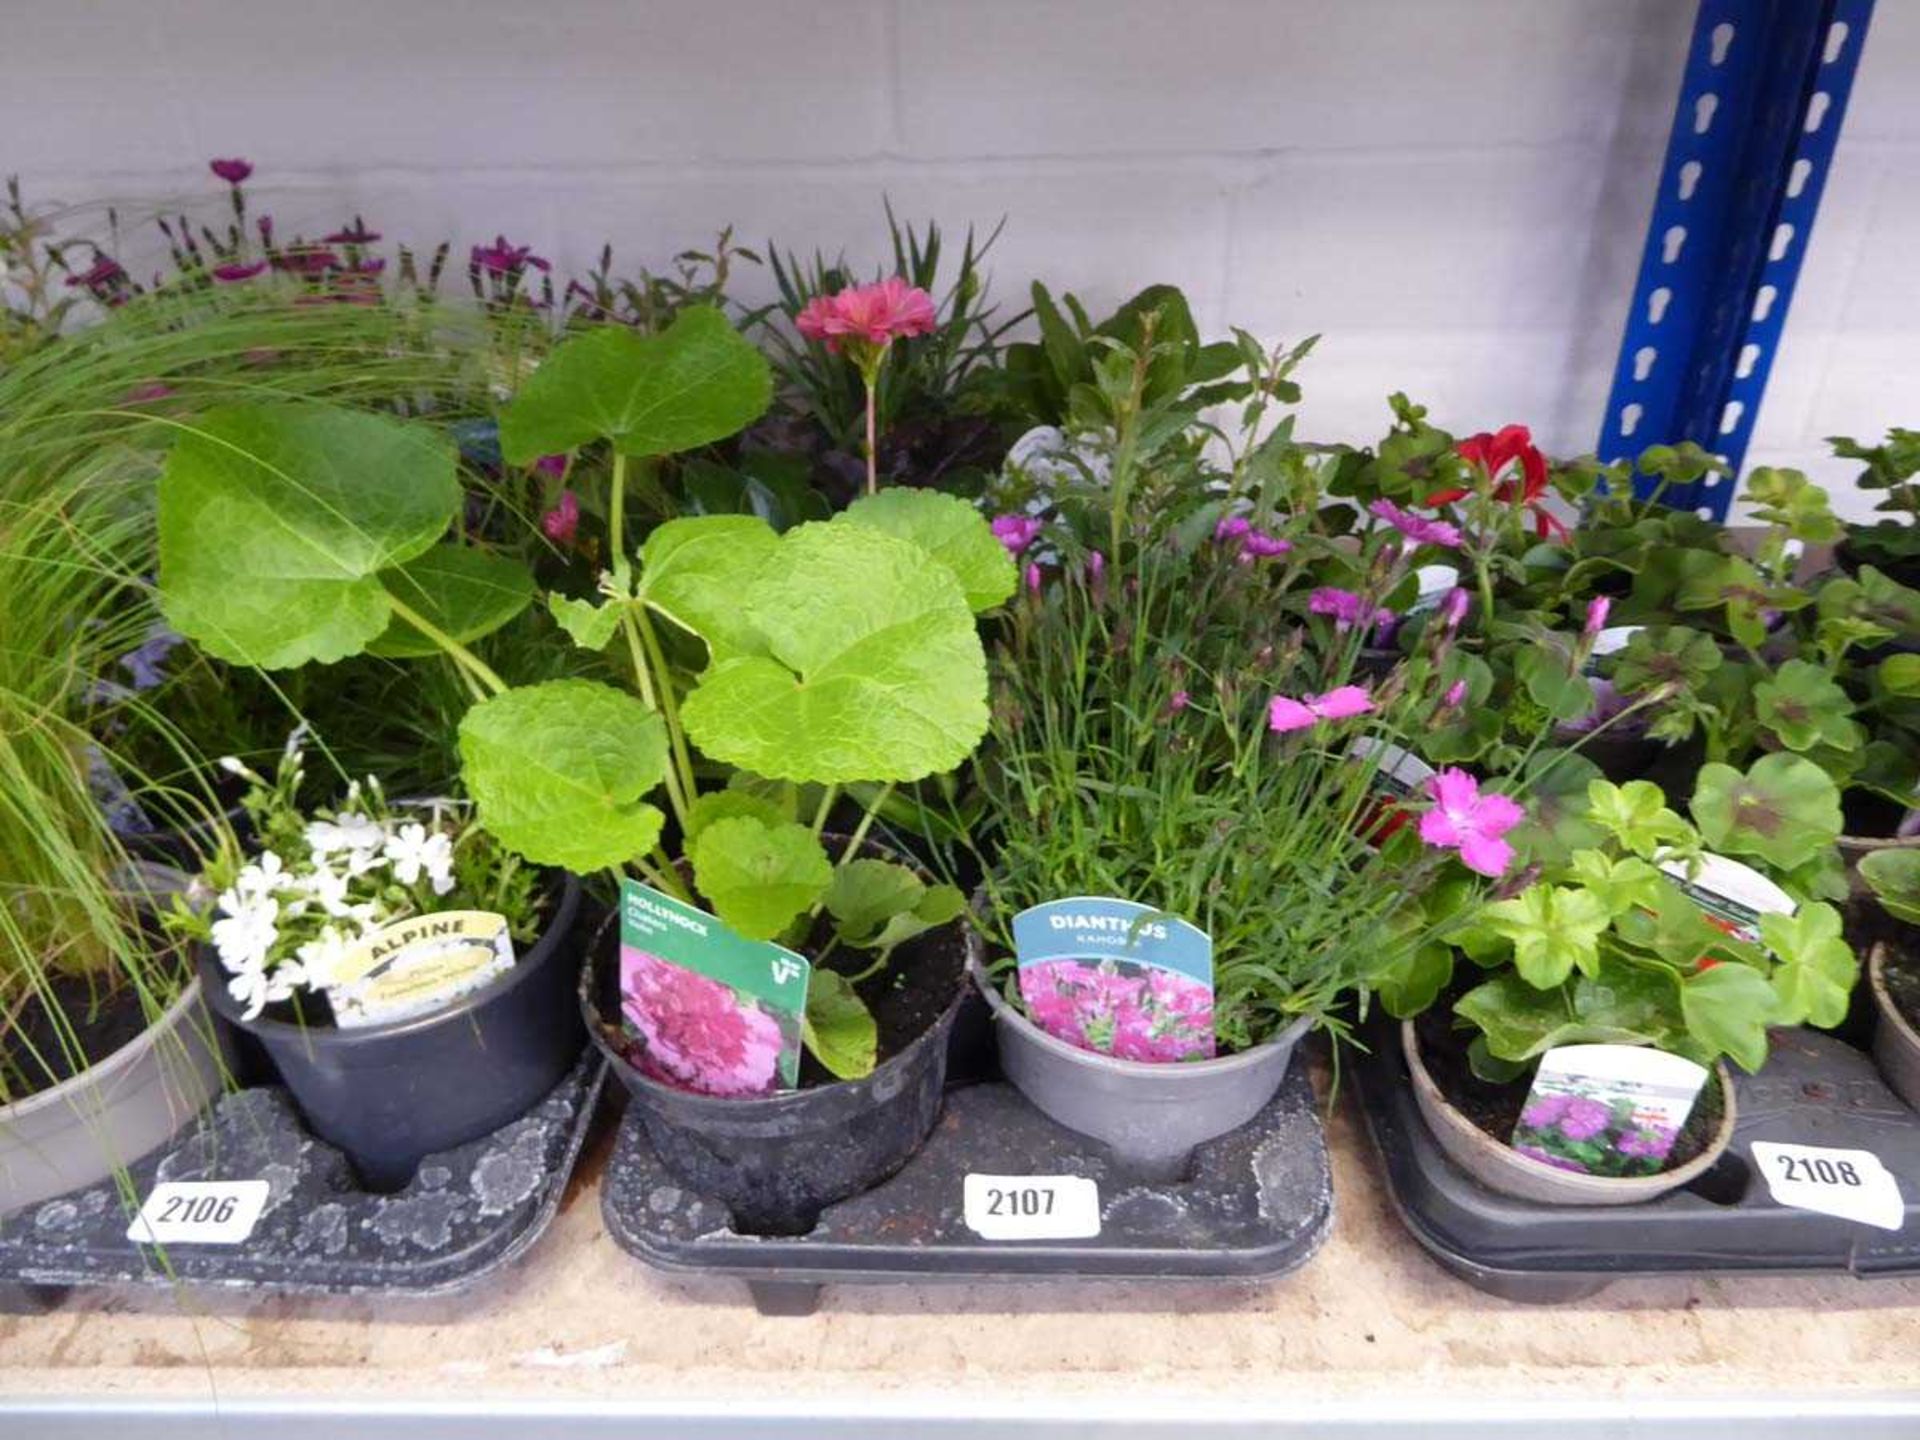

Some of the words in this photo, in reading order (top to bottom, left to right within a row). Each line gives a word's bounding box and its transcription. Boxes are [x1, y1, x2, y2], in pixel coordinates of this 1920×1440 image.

[371, 919, 465, 961] ALPINE
[1777, 1155, 1862, 1186] 2108
[157, 1196, 239, 1223] 2106
[987, 1188, 1055, 1216] 2107
